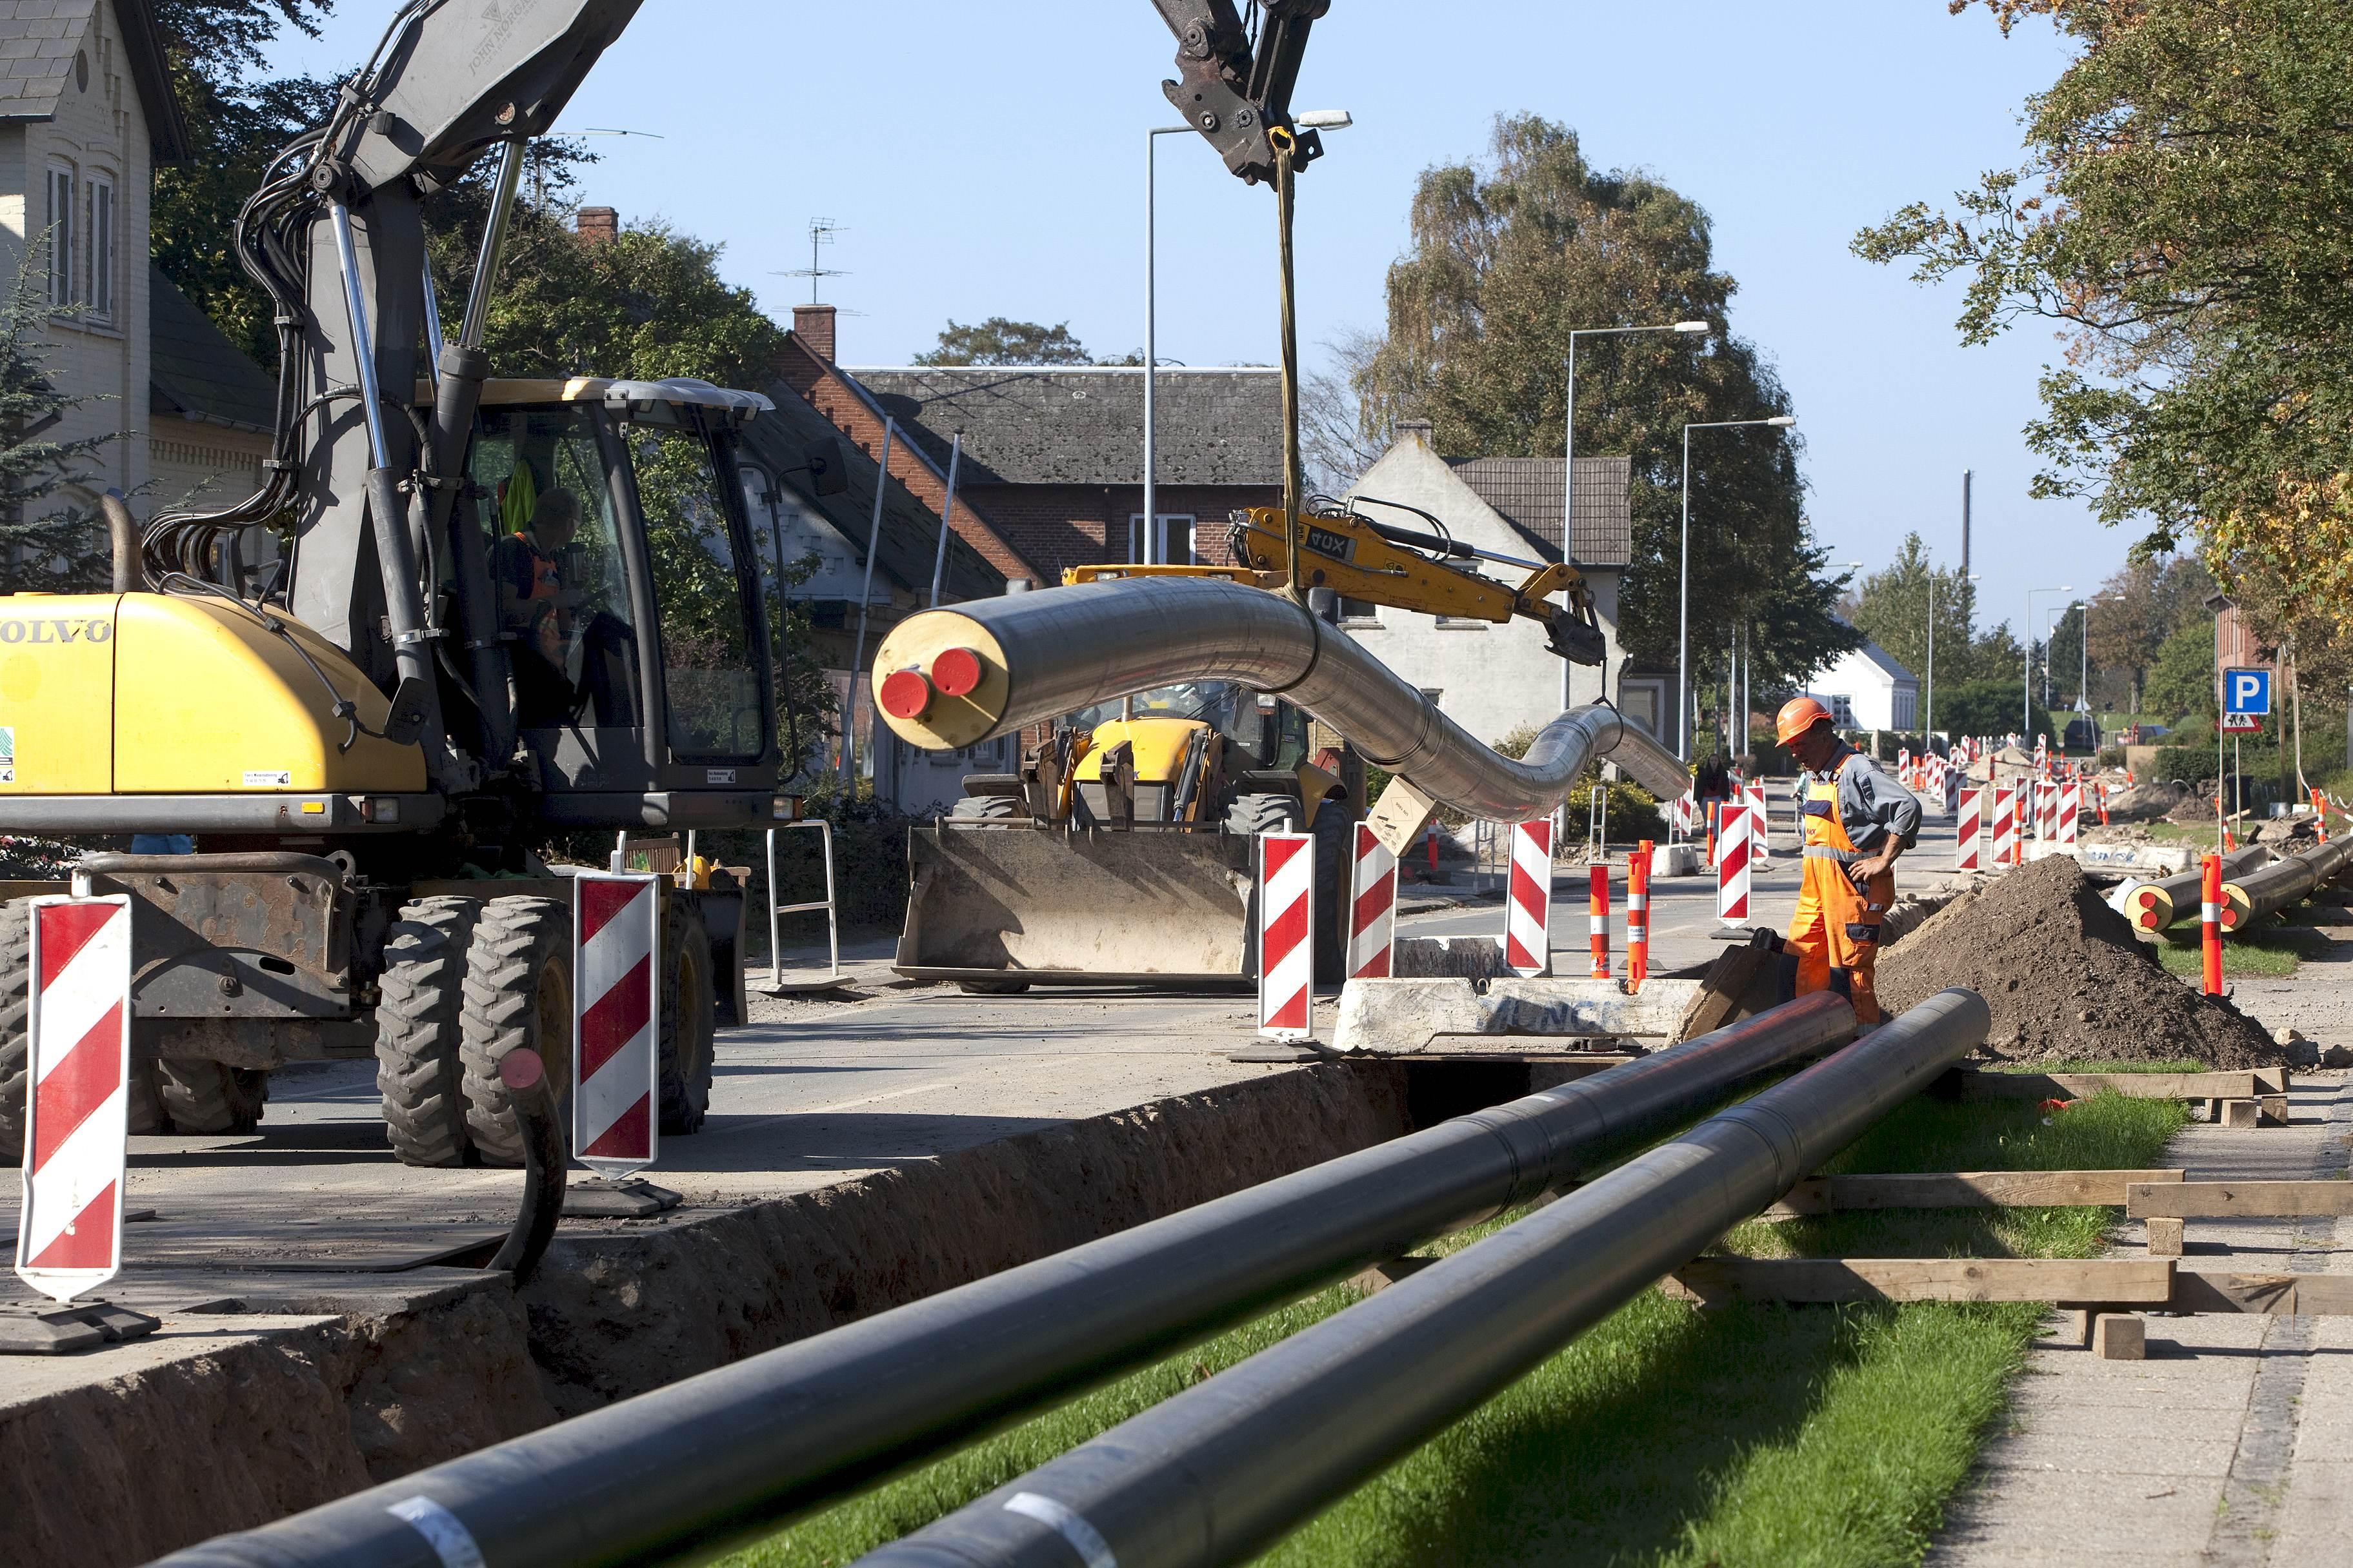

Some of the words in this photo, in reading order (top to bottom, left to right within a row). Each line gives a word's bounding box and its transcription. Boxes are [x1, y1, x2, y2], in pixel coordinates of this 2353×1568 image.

[468, 38, 495, 77] JOHN
[1312, 533, 1345, 553] 4CX
[0, 619, 112, 643] OLVO
[2236, 675, 2259, 708] P
